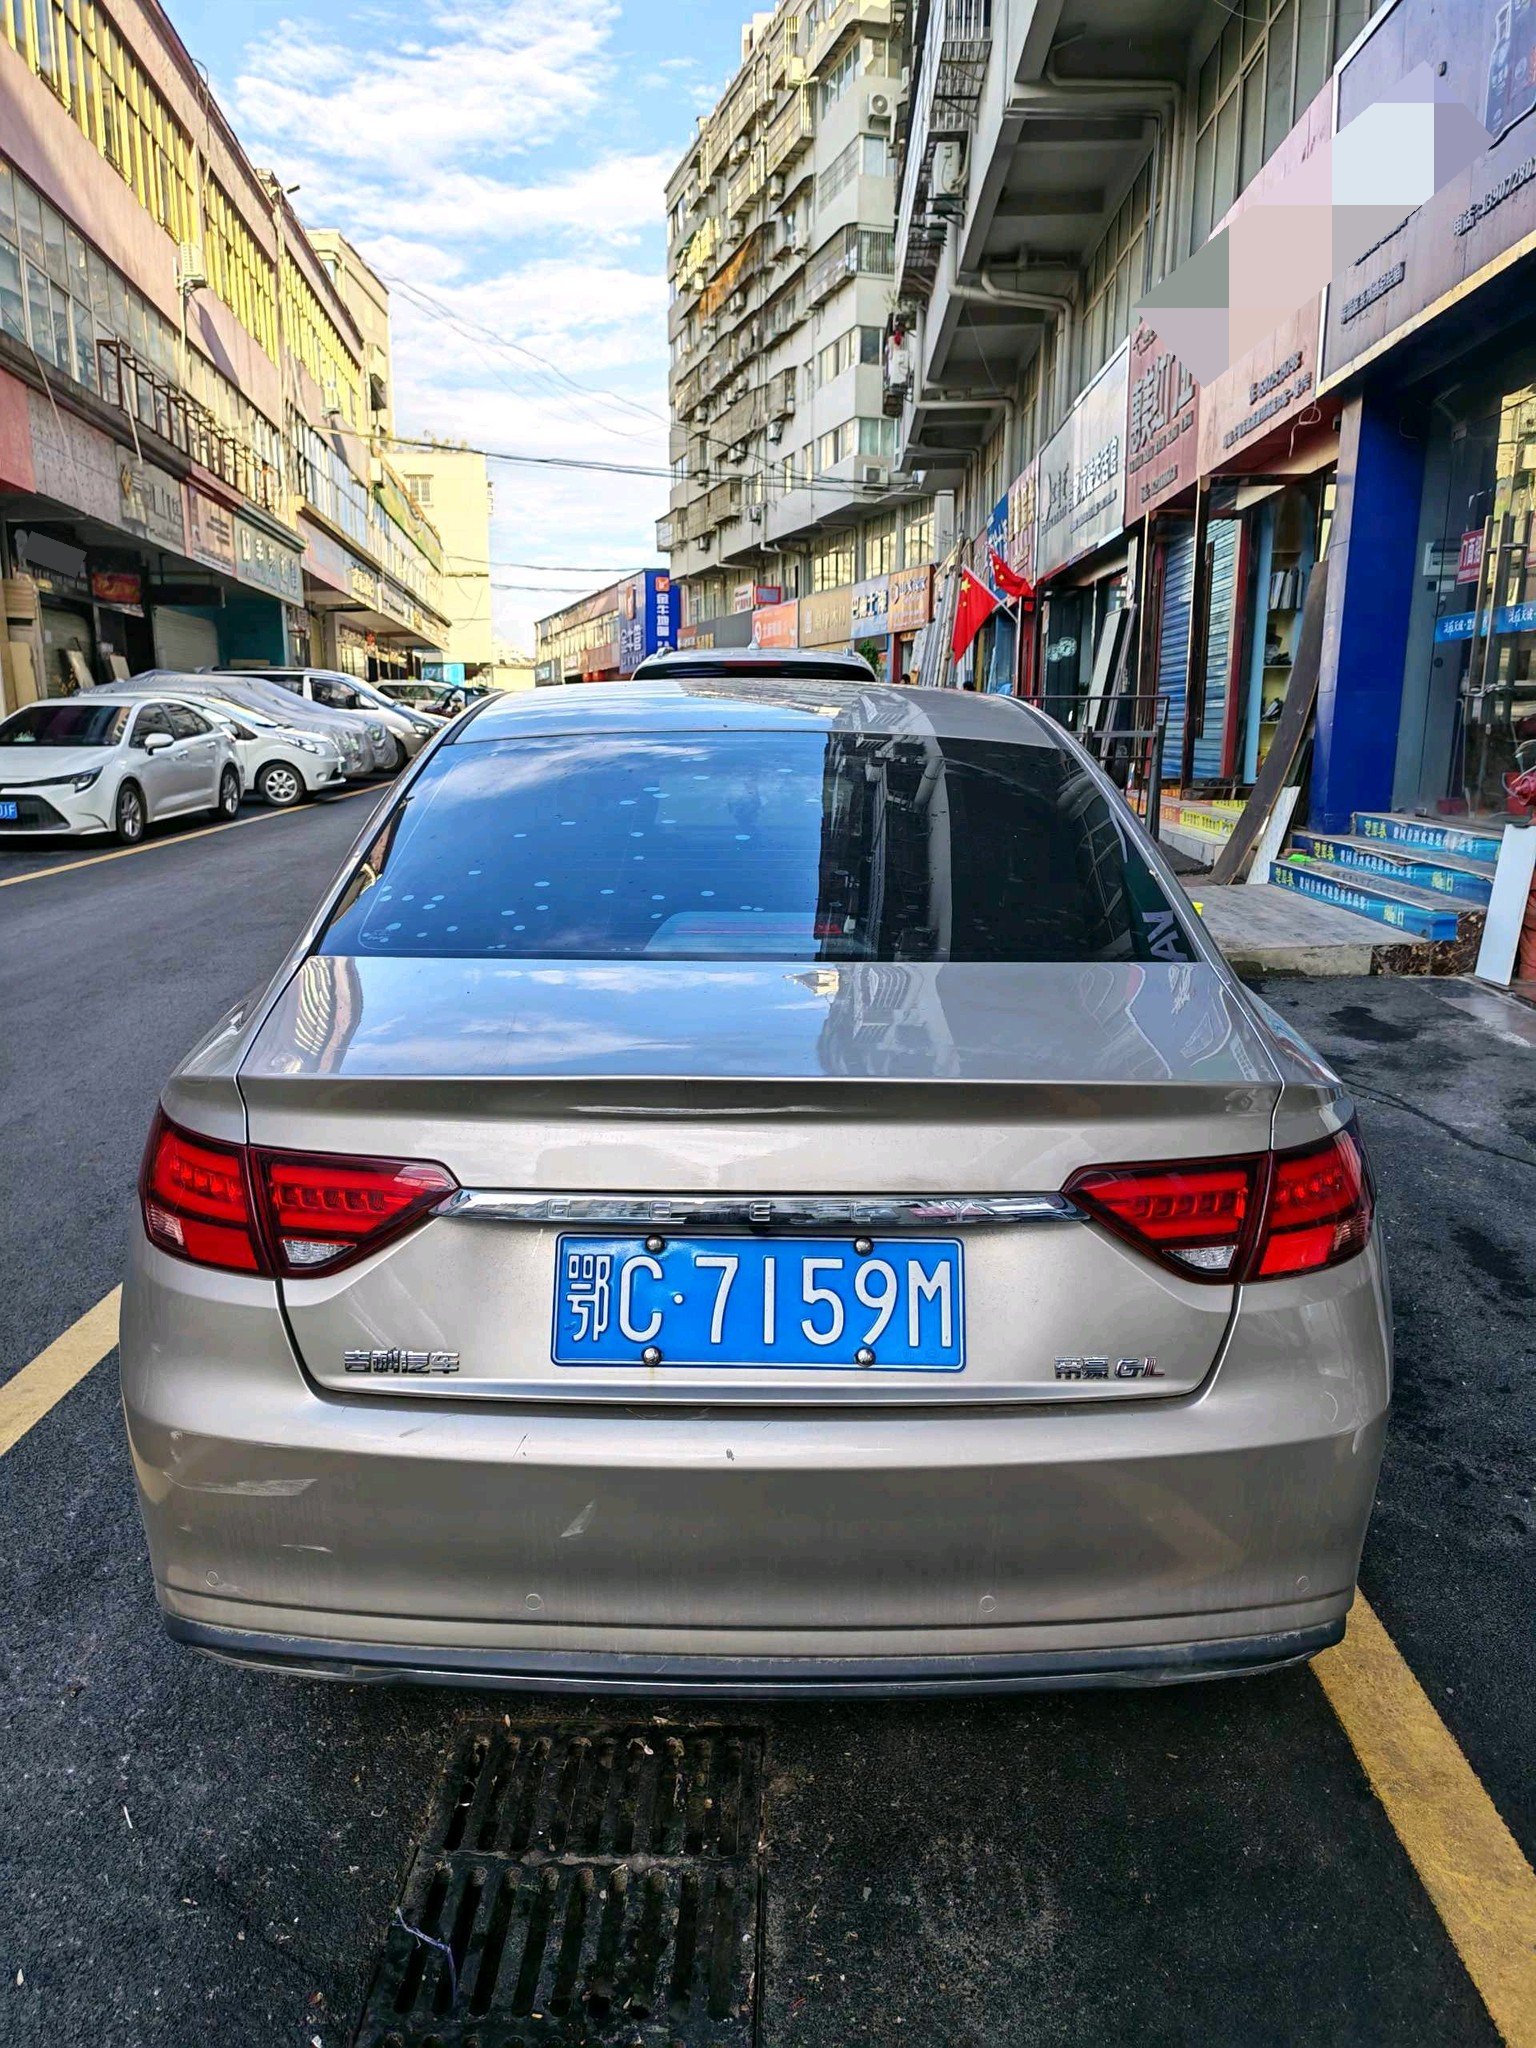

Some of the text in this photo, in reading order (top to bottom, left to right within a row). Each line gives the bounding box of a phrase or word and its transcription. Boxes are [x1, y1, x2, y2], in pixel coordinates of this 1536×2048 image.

[548, 1199, 974, 1224] GEELY
[566, 1254, 953, 1348] 鄂C·7159M
[344, 1349, 460, 1374] 吉利汽车
[1054, 1356, 1165, 1380] 帝豪 GL
